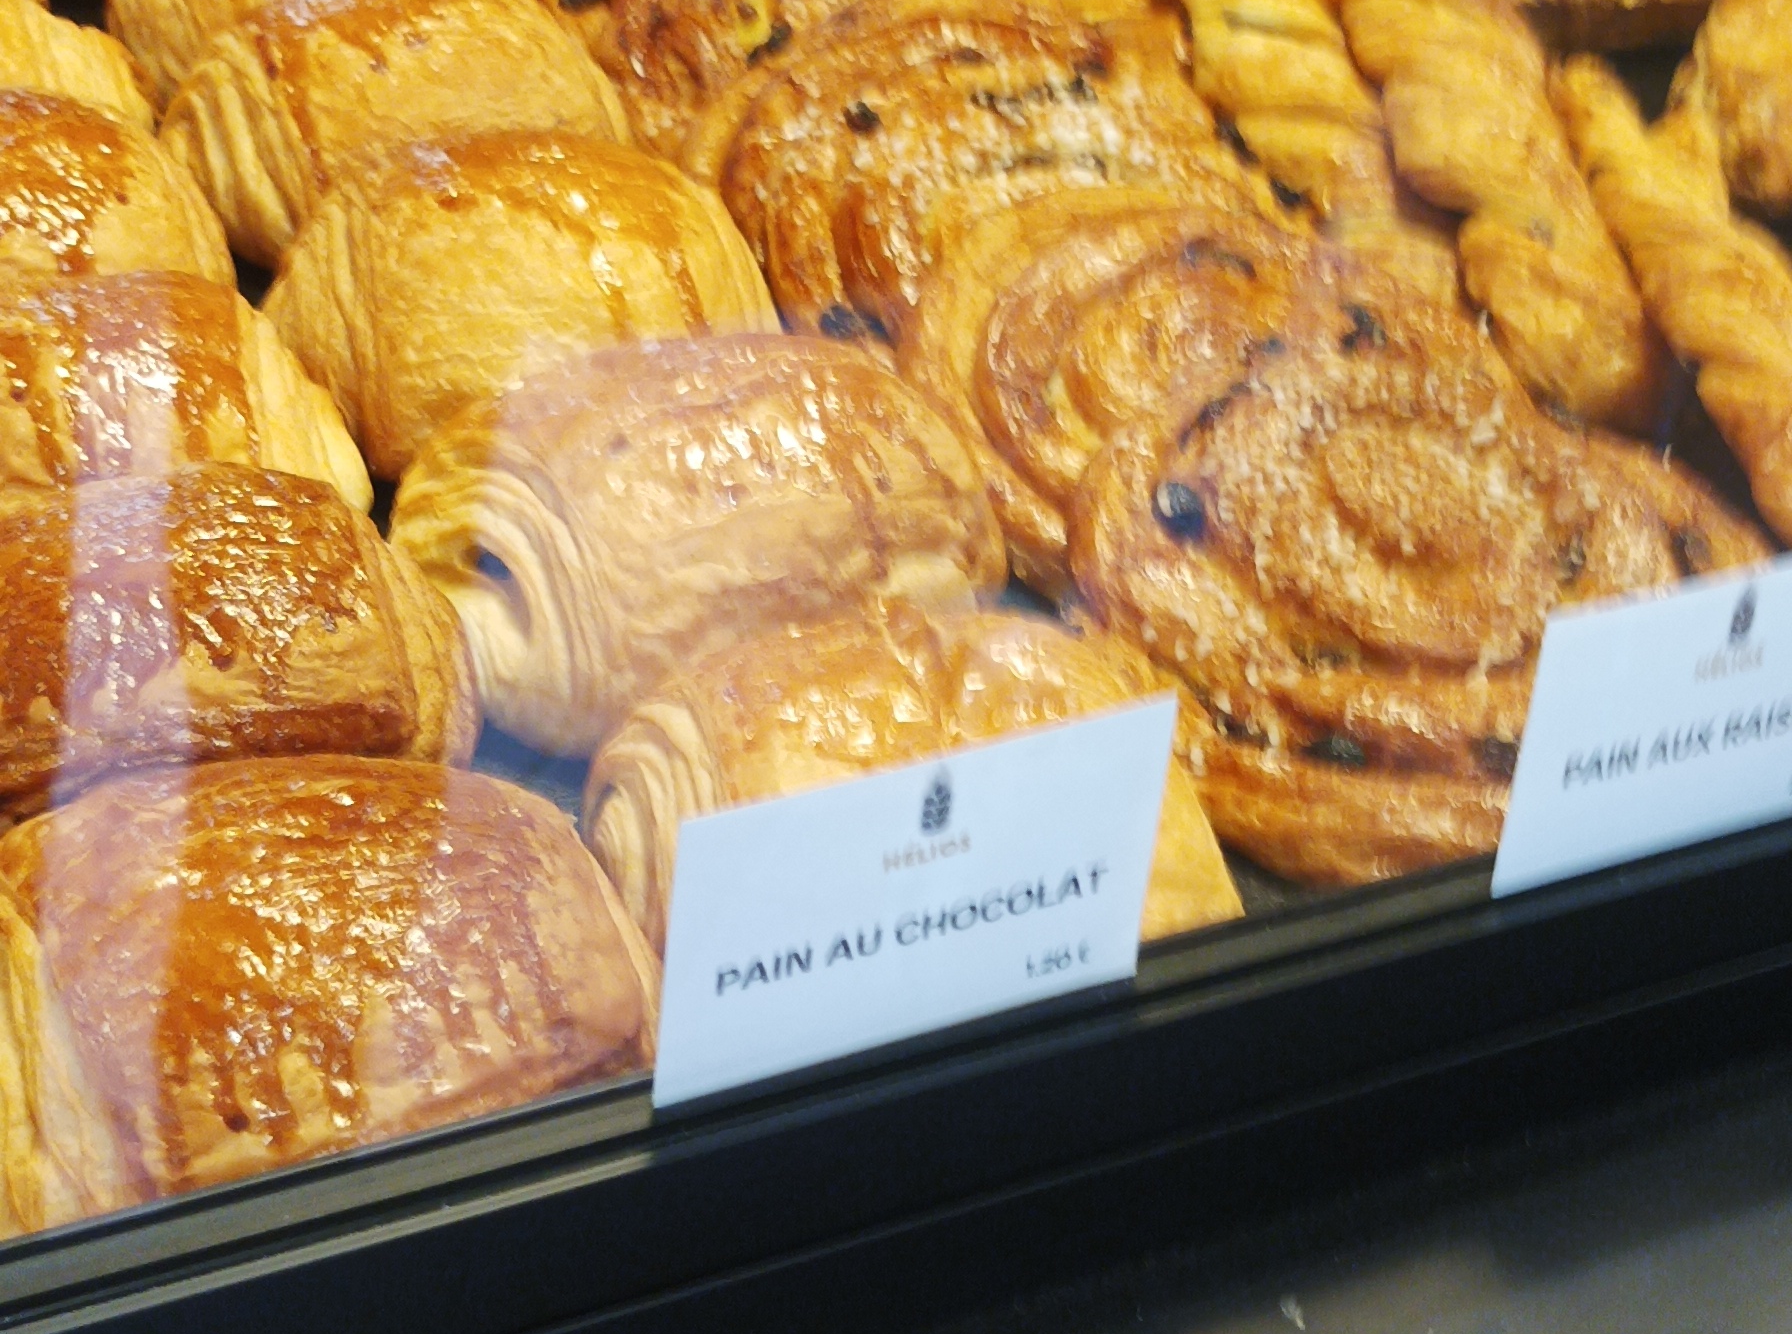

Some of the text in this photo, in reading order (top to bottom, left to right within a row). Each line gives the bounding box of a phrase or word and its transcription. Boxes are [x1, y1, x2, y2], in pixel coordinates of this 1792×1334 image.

[1562, 735, 1641, 789] PAIN
[1647, 716, 1715, 769] AUX
[716, 858, 1109, 995] PAIN AU CHOCOLAT
